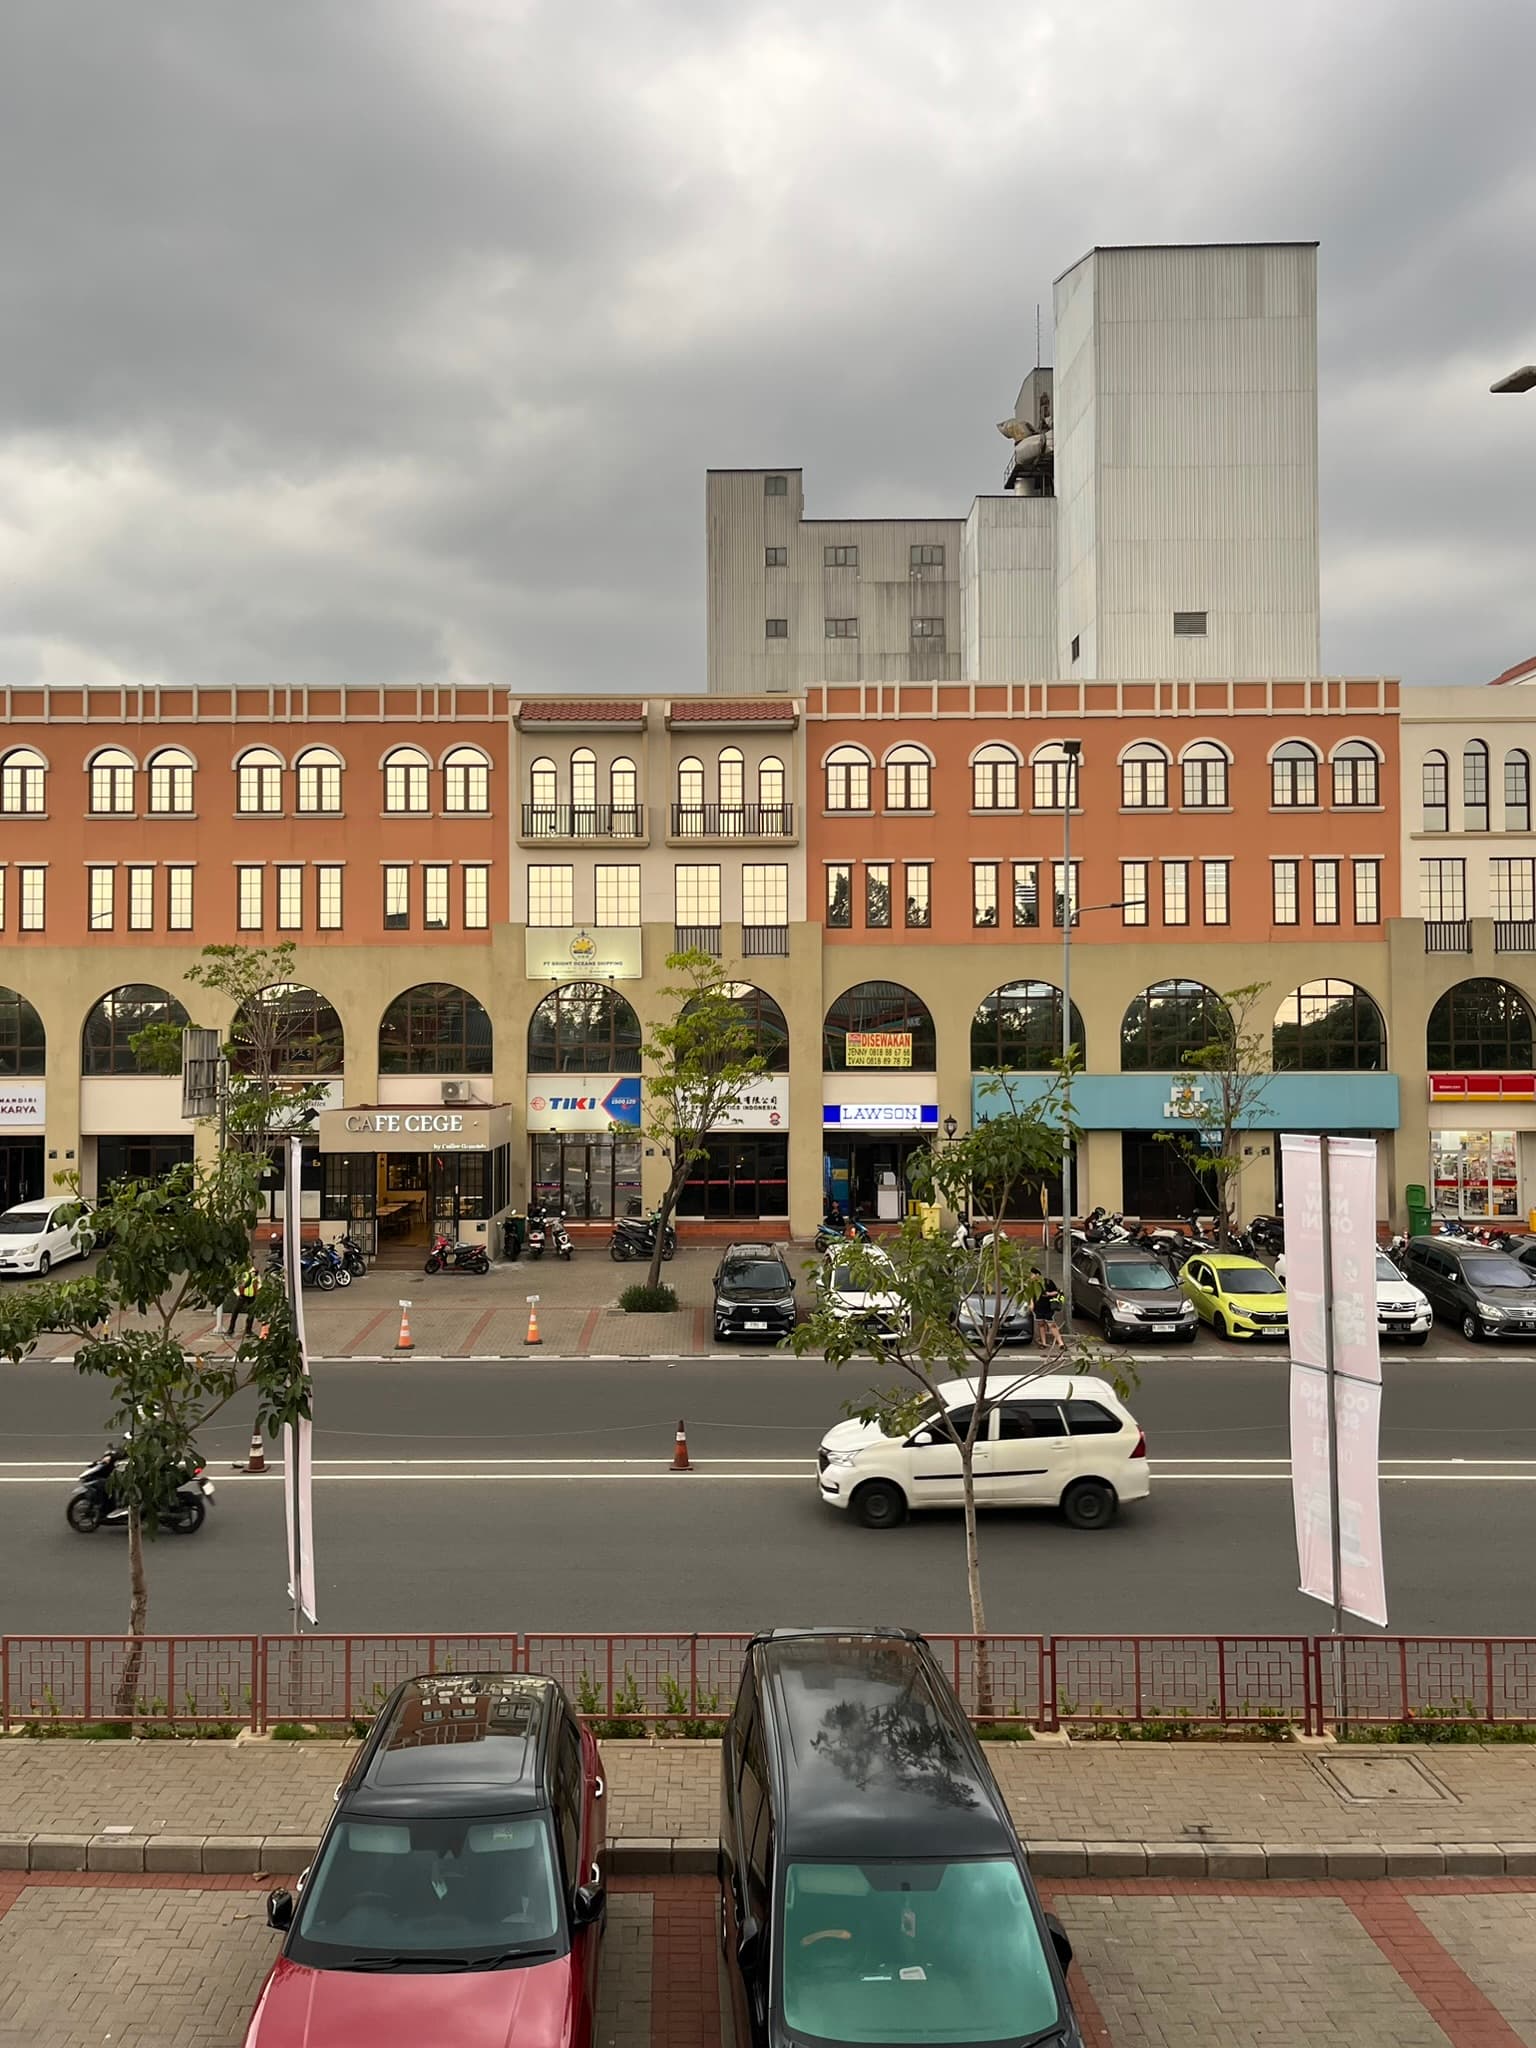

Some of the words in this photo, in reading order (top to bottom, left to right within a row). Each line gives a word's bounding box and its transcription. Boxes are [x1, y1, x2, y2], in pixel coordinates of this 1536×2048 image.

[861, 1034, 911, 1047] DISEWAKAN
[549, 1097, 596, 1110] TIKI
[842, 1108, 918, 1120] LAWSON
[345, 1115, 400, 1133] CAFE
[404, 1115, 464, 1133] CEGE
